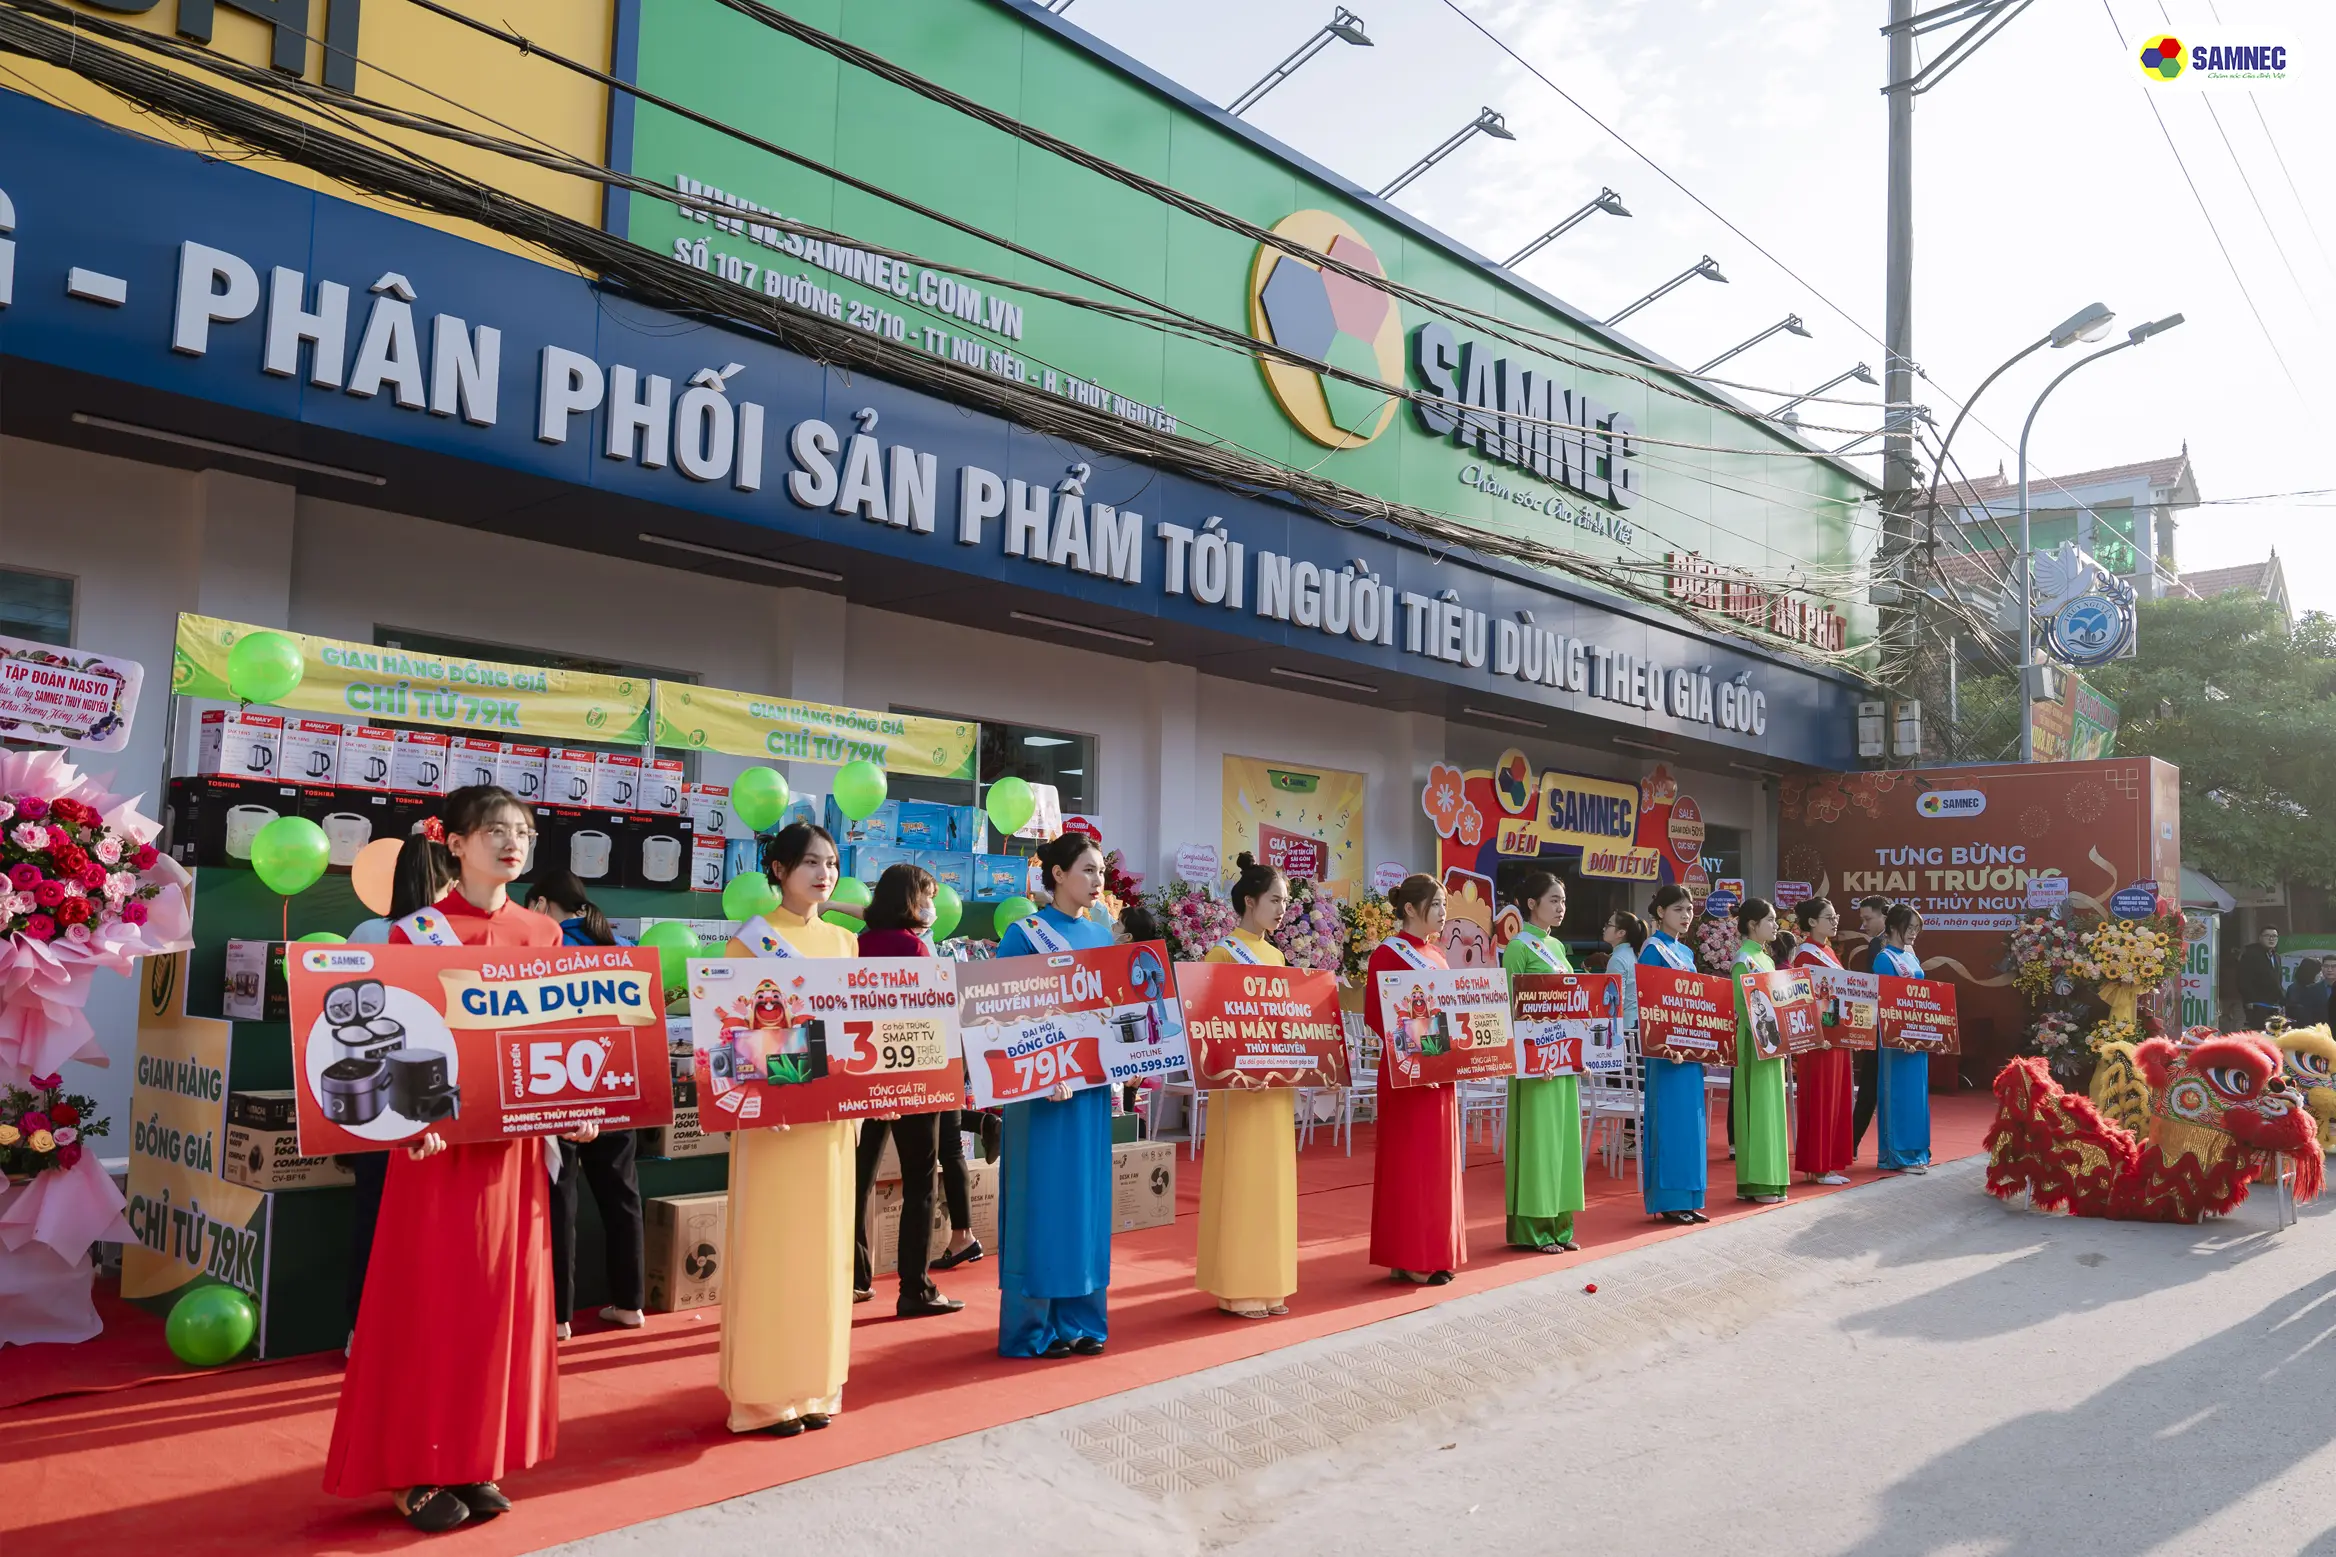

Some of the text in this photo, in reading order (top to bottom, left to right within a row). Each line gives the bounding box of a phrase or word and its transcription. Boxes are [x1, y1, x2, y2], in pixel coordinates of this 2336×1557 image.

[676, 173, 1023, 341] WWW.SAMNEC.COM.VN
[673, 236, 712, 272] SỐ
[714, 252, 758, 289] 107
[764, 269, 842, 320] ĐƯỜNG
[847, 300, 905, 342] 25/10
[922, 326, 948, 356] TT
[951, 336, 985, 370] NÚI
[1413, 321, 1639, 510] SAMNEC
[172, 239, 1766, 737] PHÂN PHỐI SẢN PHẨM TỚI NGƯỜI TIÊU DÙNG THEO GIÁ GỐC
[5, 664, 29, 683] TẬP
[68, 677, 109, 697] NASYO
[321, 646, 548, 694] GIAN HÀNG ĐỒNG GIÁ
[34, 689, 63, 706] SAMNEC
[346, 680, 522, 729] CHỈ TỪ 79K
[749, 702, 905, 736] GIAN HÀNG ĐỒNG GIÁ
[766, 728, 887, 767] CHỈ TỪ 79K
[208, 780, 241, 789] TOSHIBA
[305, 789, 335, 797] TOSHIBA
[1549, 788, 1631, 838] SAMNEC
[1678, 808, 1694, 820] SALE
[1942, 798, 1979, 809] SAMNEC
[1269, 836, 1287, 851] GIÁ
[1503, 821, 1538, 853] ĐẾN
[1590, 848, 1658, 875] ĐÓN TẾT VỀ
[1875, 842, 2026, 865] TƯNG BỪNG
[1843, 870, 1915, 892] KHAI
[1926, 892, 1975, 909] THỦY
[1943, 917, 1968, 927] nhận
[1971, 917, 1991, 928] quà
[1993, 916, 2012, 928] gấp
[331, 955, 366, 966] SAMNEC
[481, 949, 634, 983] ĐẠI HỘI GIẢM GIÁ
[847, 966, 920, 988] BỐC THĂM
[964, 975, 1059, 999] KHAI TRƯƠNG
[1060, 964, 1103, 1004] LỚN
[1243, 976, 1290, 998] 07.01
[1455, 976, 1490, 990] BỐC THĂM
[1675, 978, 1704, 997] 07.01
[461, 979, 642, 1017] GIA DỤNG
[809, 985, 956, 1011] 100% TRÚNG THƯỞNG
[1437, 990, 1508, 1006] 100% TRÚNG THƯỞNG
[1519, 990, 1568, 1001] KHAI TRƯƠNG
[1567, 985, 1589, 1012] LỚN
[1787, 983, 1810, 999] DỤNG
[1906, 984, 1930, 999] 07.01
[975, 992, 1060, 1015] KHUYẾN MẠI
[1224, 1001, 1312, 1017] KHAI TRƯƠNG
[1523, 1000, 1566, 1014] KHUYẾN MẠI
[1190, 1016, 1343, 1043] ĐIỆN MÁY SAMNEC
[1475, 1020, 1492, 1028] SMART
[1640, 1005, 1734, 1032] ĐIỆN MÁY SAMNEC
[882, 1031, 935, 1042] SMART TV
[1022, 1021, 1055, 1040] ĐẠI HỘI
[1455, 1012, 1473, 1049] 3
[1475, 1030, 1491, 1045] 9.9
[843, 1020, 878, 1075] 3
[917, 1044, 941, 1056] TRIỆU
[1007, 1029, 1067, 1058] ĐỒNG GIÁ
[1129, 1047, 1162, 1060] HOTLINE
[1245, 1040, 1306, 1054] THỦY NGUYÊN
[883, 1045, 915, 1069] 9.9
[917, 1052, 944, 1065] ĐỒNG
[1013, 1041, 1083, 1092] 79K
[1110, 1055, 1185, 1078] 1900.599.922
[1538, 1040, 1573, 1071] 79K
[138, 1054, 223, 1103] GIAN HÀNG
[511, 1043, 525, 1098] GIẢM ĐẾN
[838, 1089, 955, 1112] HÀNG TRĂM TRIỆU ĐỒNG
[868, 1081, 926, 1097] TỔNG GIÁ TRỊ
[502, 1106, 606, 1124] SAMNEC THỦY NGUYÊN
[134, 1112, 213, 1175] ĐỒNG GIÁ
[271, 1173, 306, 1182] CV-BF16
[128, 1188, 258, 1294] CHỈ TỪ 79K
